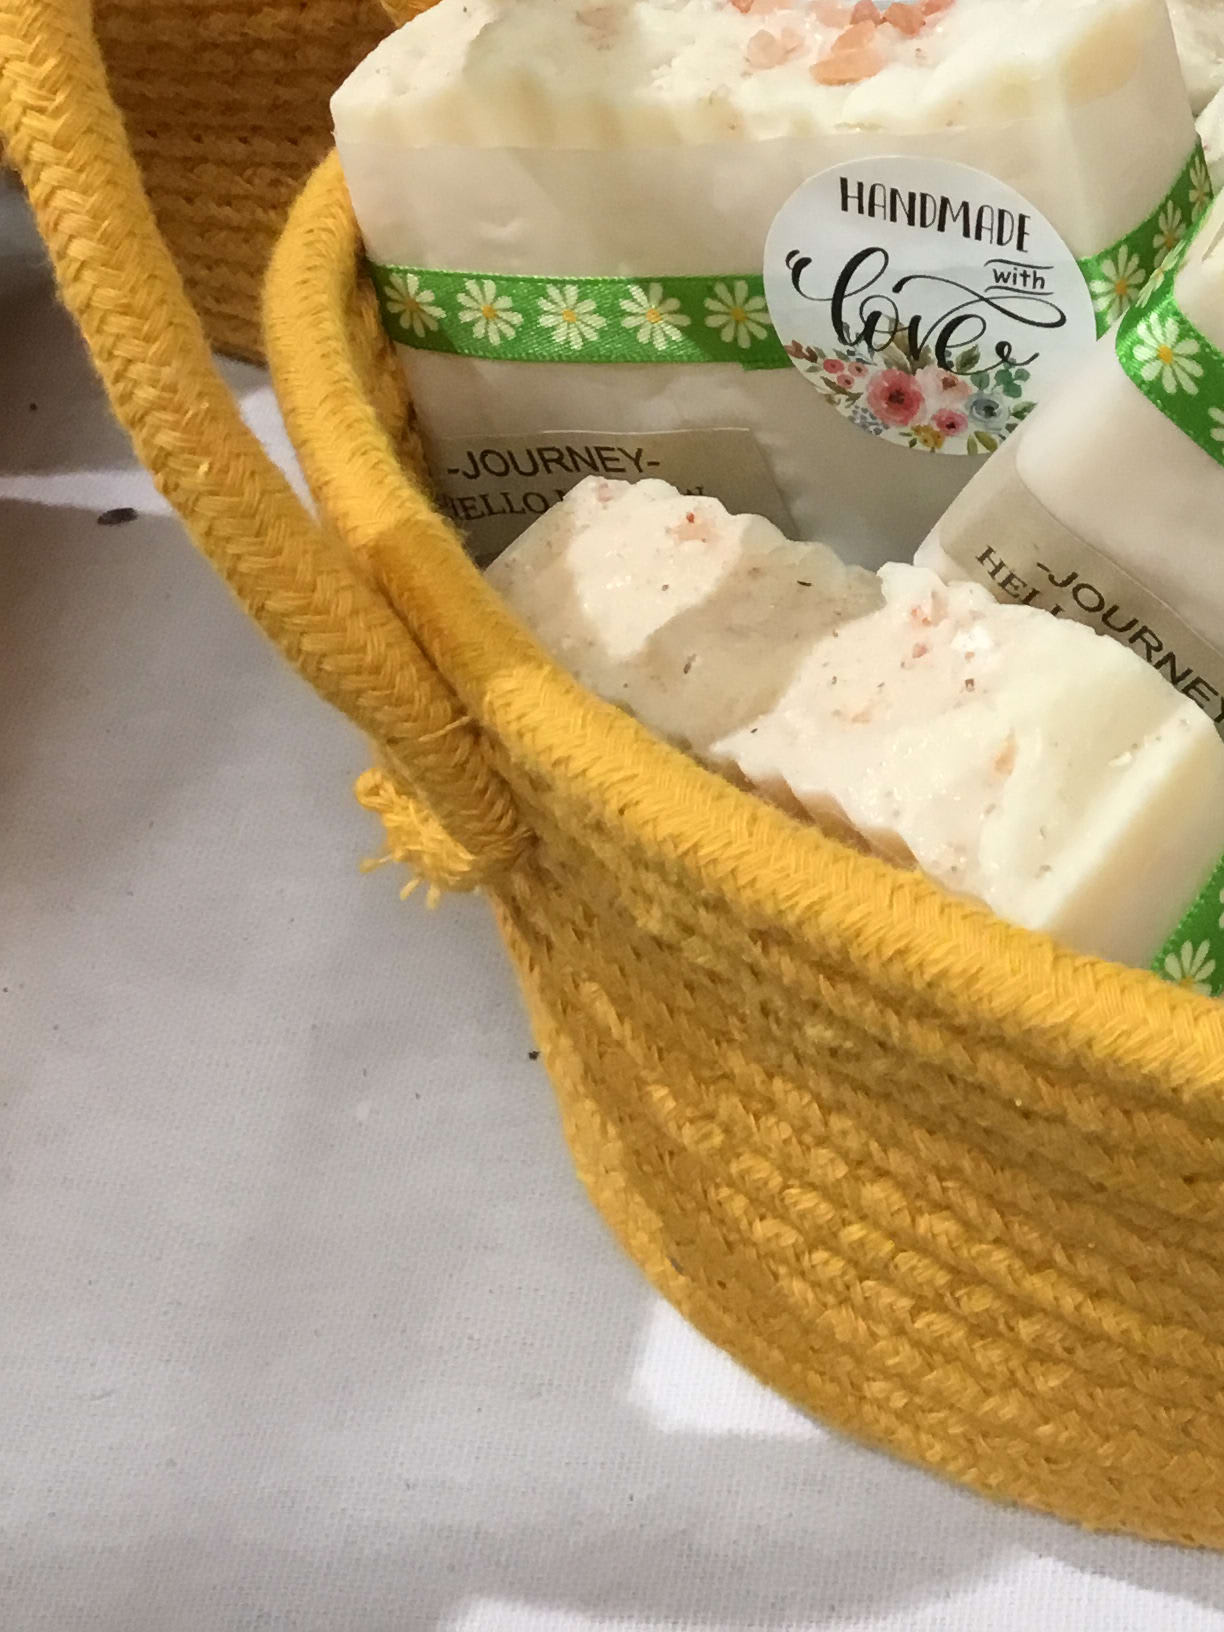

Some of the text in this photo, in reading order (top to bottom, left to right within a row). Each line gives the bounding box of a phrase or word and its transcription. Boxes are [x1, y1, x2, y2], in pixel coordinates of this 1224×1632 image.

[838, 176, 1033, 254] HANDMADE
[993, 266, 1047, 291] with
[447, 446, 661, 480] -JOURNEY-
